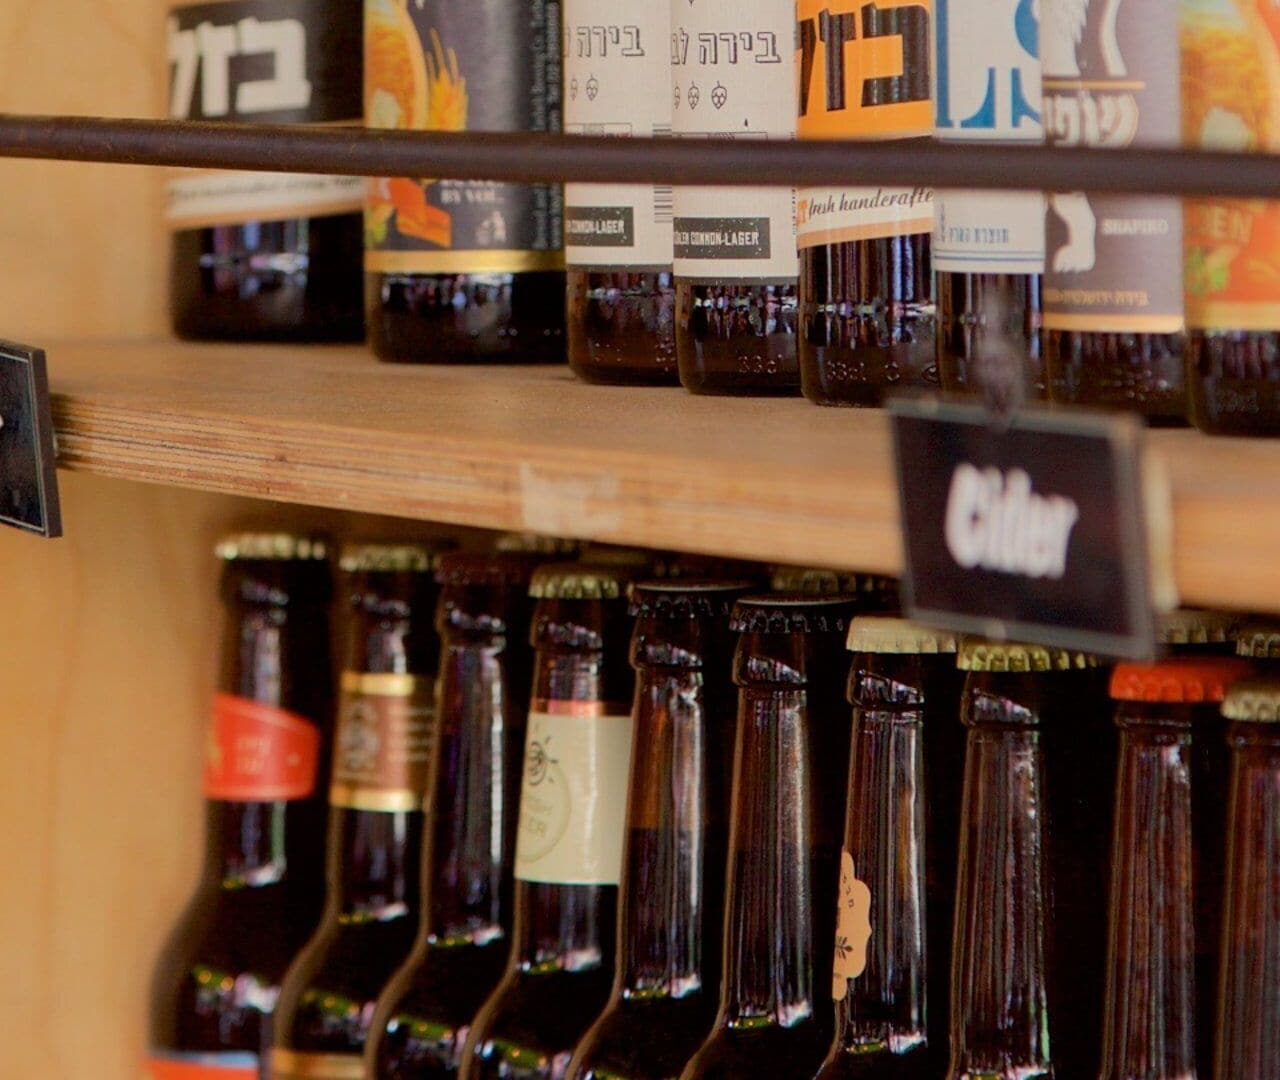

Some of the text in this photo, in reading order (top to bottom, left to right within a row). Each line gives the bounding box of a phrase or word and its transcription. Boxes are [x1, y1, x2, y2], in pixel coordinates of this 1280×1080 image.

[577, 25, 645, 57] בירה
[698, 31, 782, 64] בירה
[167, 18, 311, 118] בזל
[808, 186, 934, 217] fresh handcrafte
[1102, 218, 1169, 235] SHAPIRO
[945, 463, 1080, 580] Cider
